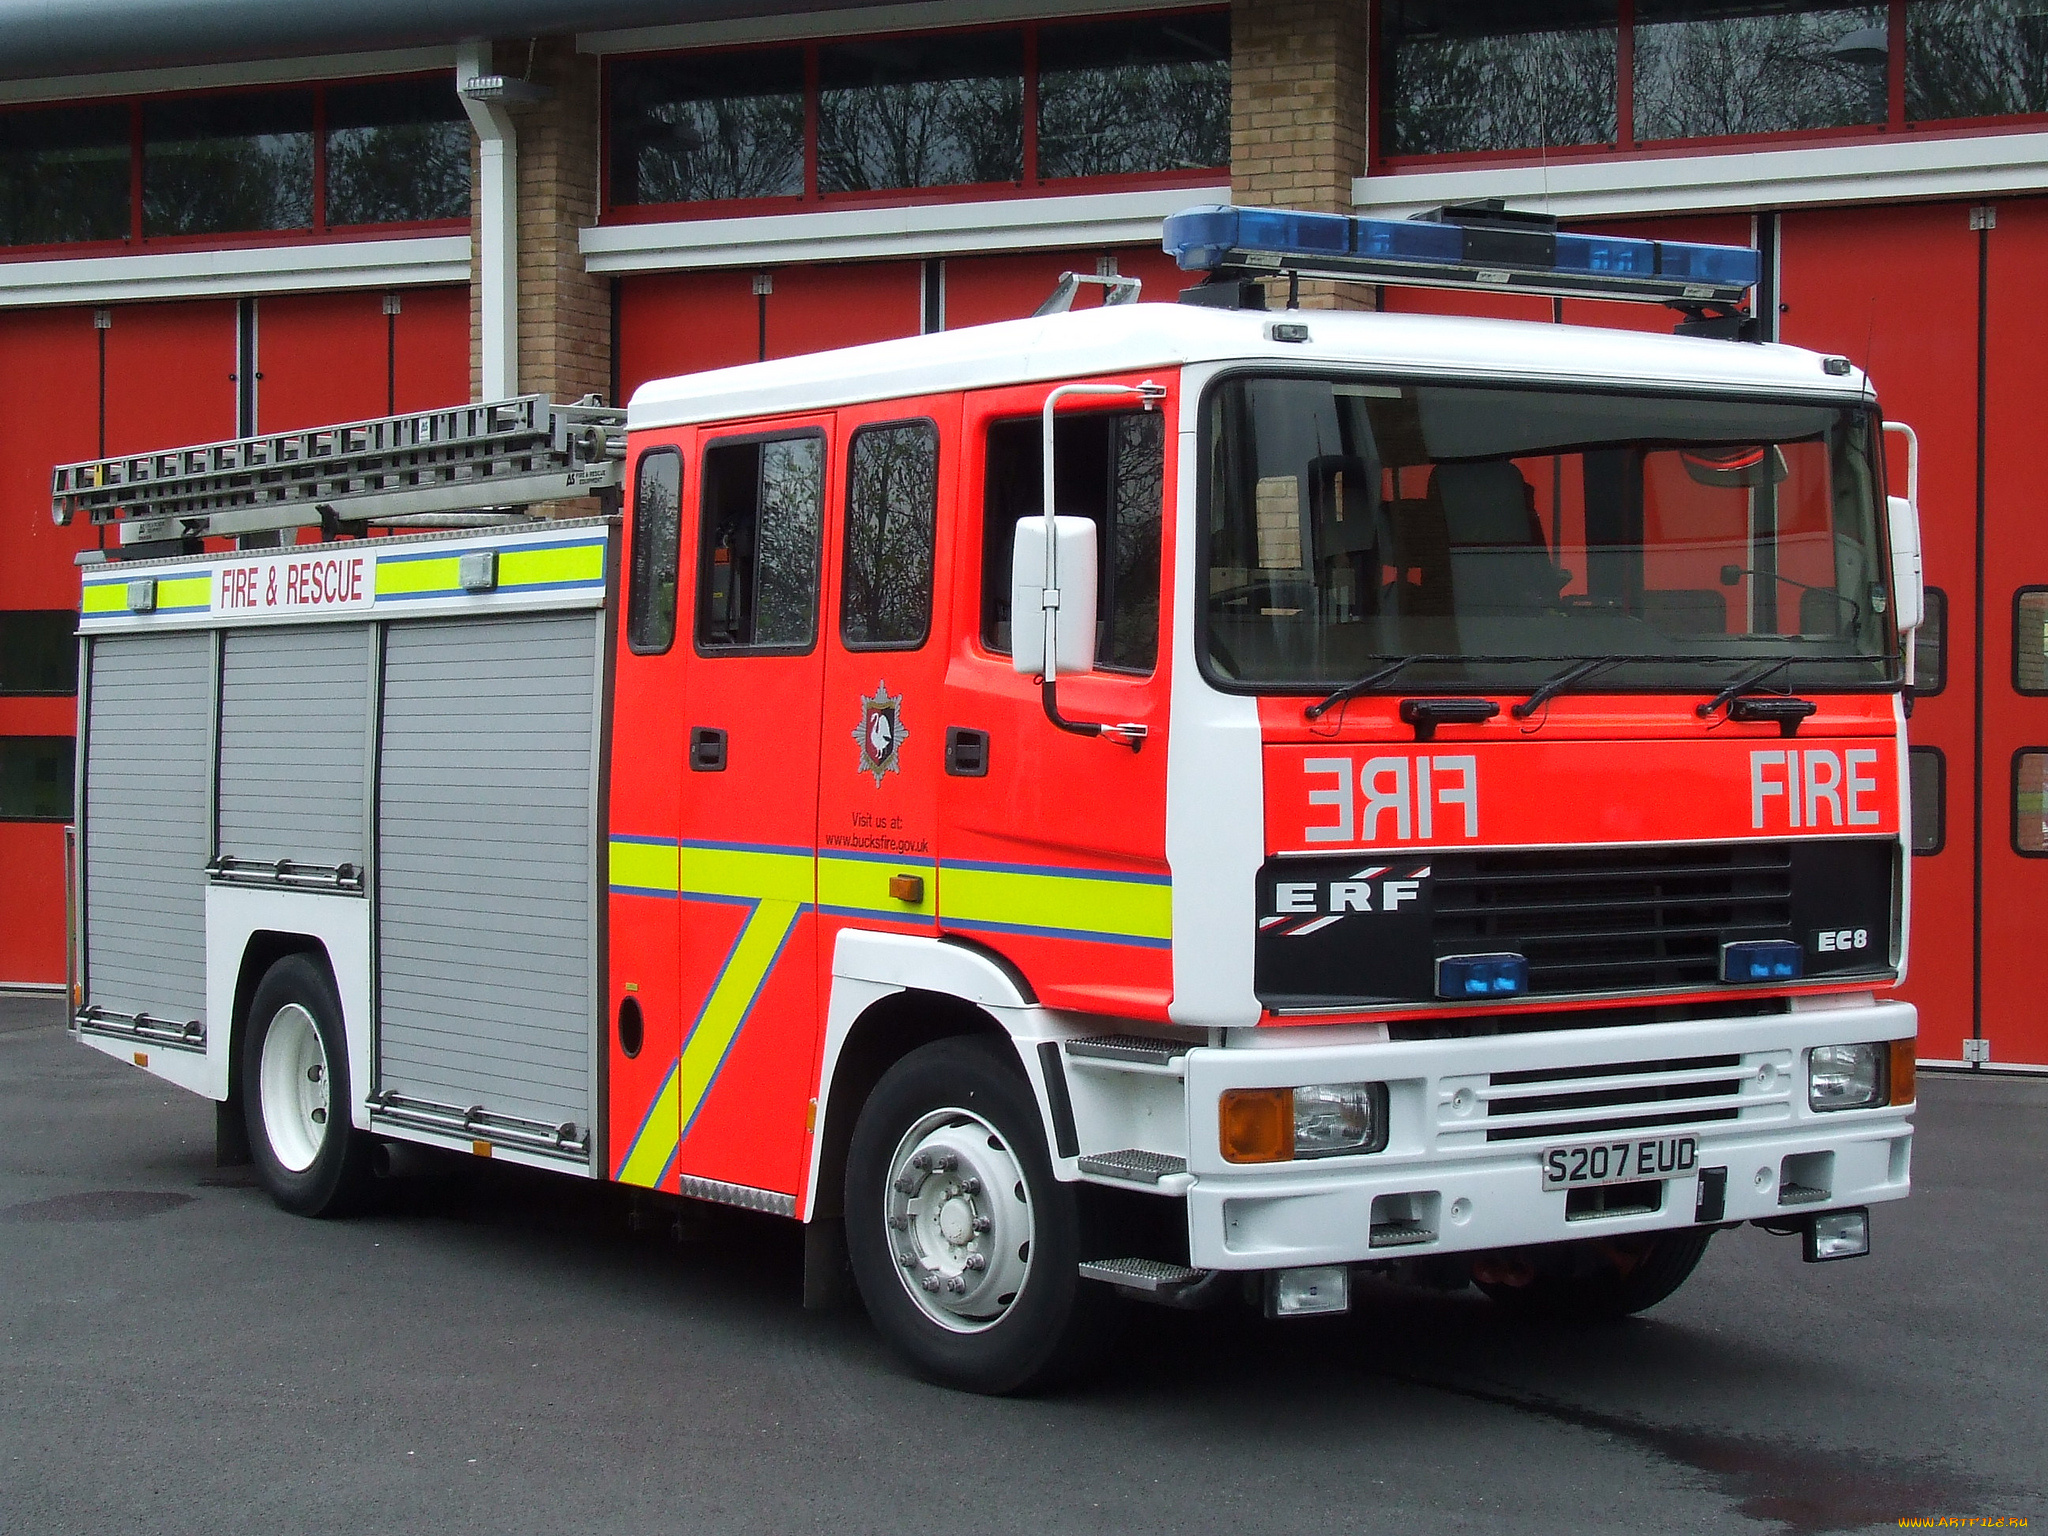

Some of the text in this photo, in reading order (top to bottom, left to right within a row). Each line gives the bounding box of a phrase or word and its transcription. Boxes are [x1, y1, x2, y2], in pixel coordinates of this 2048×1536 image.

[221, 558, 364, 609] FIRE & RESCUE
[1750, 748, 1880, 829] FIRE
[852, 812, 903, 830] Visit us at:
[826, 833, 929, 855] www.bucksfire.gov.uk
[1276, 881, 1420, 913] ERF
[1818, 929, 1868, 953] EC8
[1548, 1137, 1696, 1183] S207 EUD
